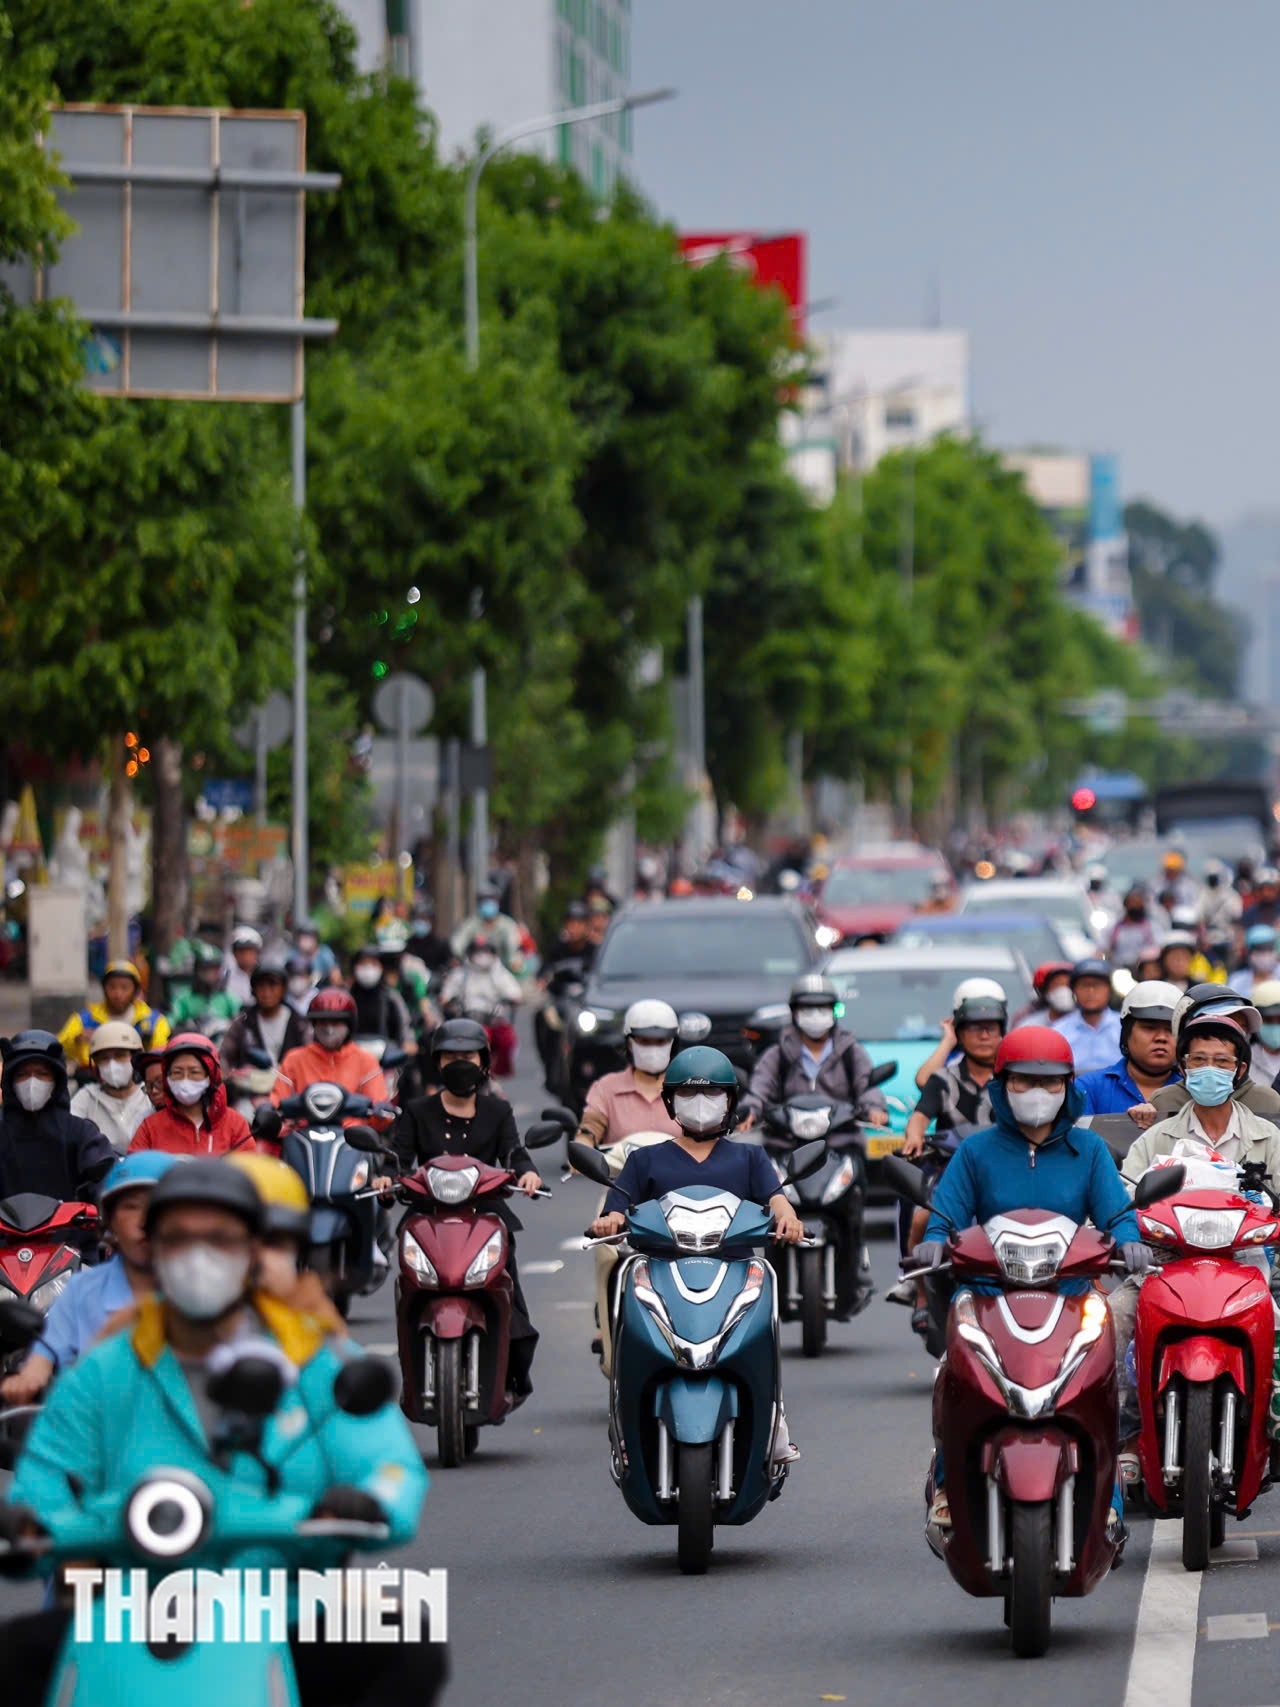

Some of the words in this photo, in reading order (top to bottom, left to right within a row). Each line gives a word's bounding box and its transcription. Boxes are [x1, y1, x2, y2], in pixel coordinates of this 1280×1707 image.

[684, 1259, 715, 1267] HONDA
[1192, 1259, 1221, 1267] HONDA
[1016, 1292, 1047, 1300] HONDA
